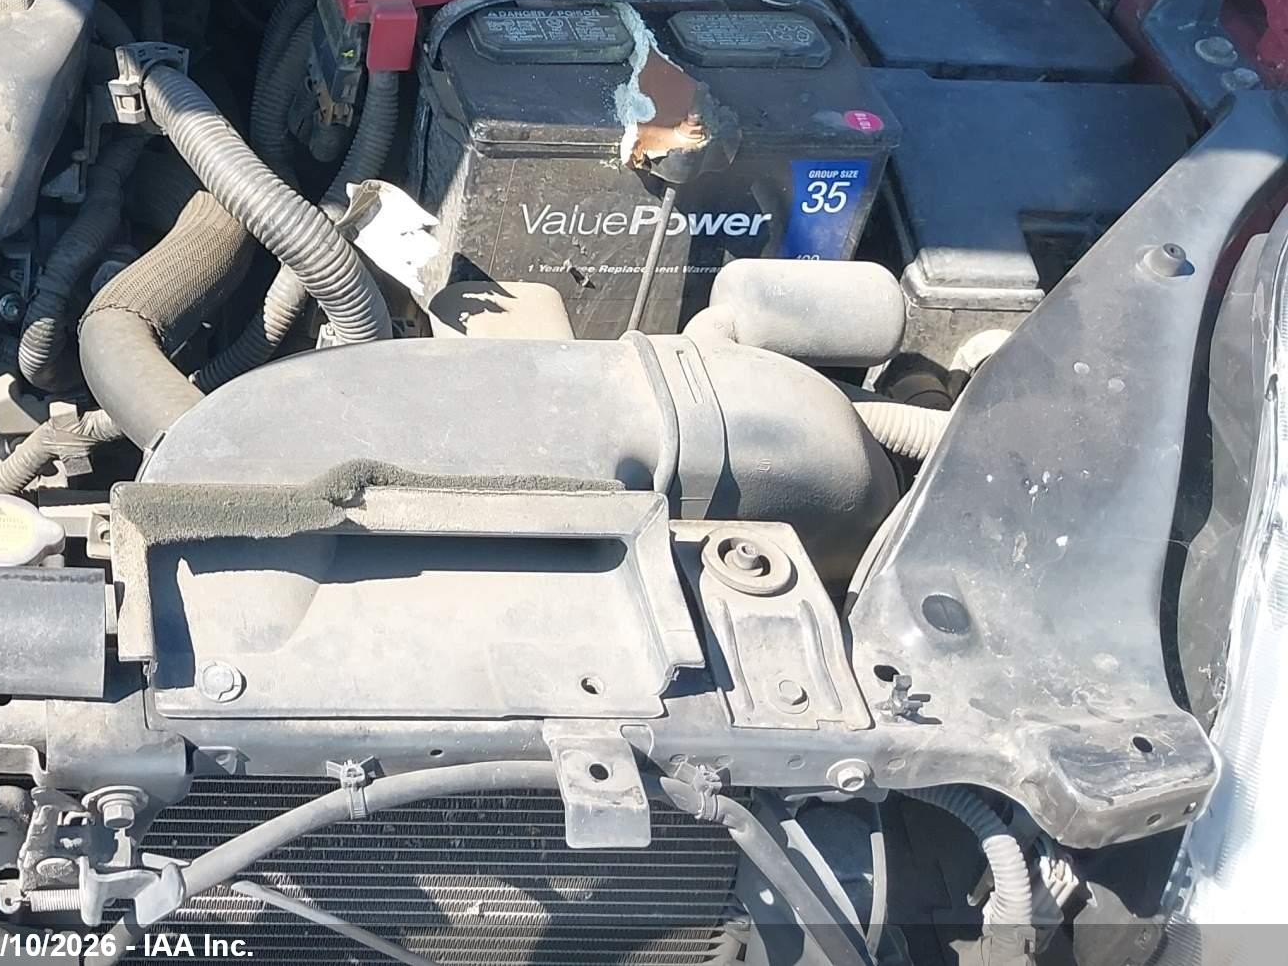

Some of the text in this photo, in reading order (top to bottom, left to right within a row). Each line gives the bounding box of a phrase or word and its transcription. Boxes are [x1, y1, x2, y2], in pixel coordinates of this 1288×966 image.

[498, 10, 546, 18] DANGER
[808, 169, 859, 179] GROUP SIZE
[801, 180, 851, 214] 35
[520, 203, 772, 236] ValuePower
[539, 265, 565, 273] Year
